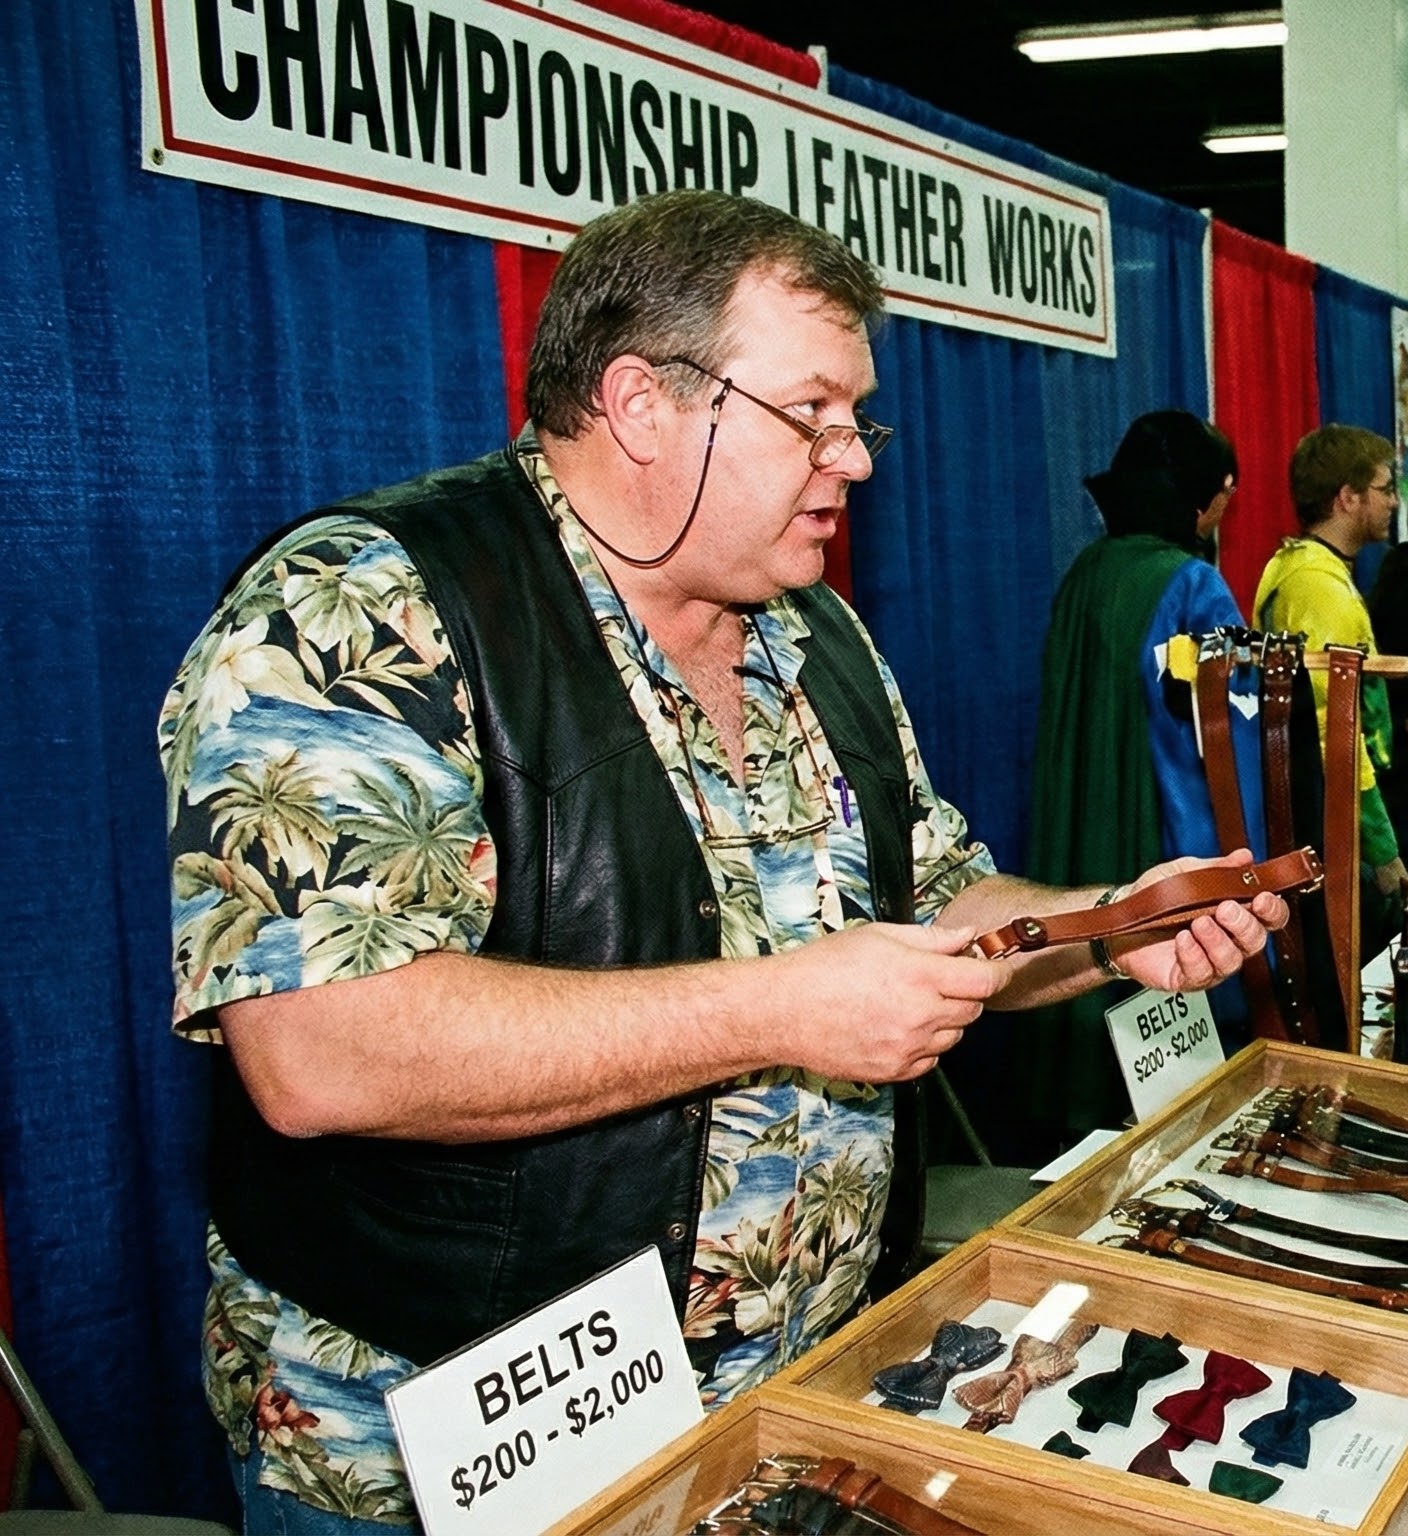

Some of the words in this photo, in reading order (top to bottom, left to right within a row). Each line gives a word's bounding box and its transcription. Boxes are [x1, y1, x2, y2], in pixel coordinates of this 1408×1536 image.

[196, 0, 759, 206] CHAMPIONSHIP
[982, 194, 1096, 318] WORKS
[1134, 1047, 1163, 1082] $200
[1171, 1018, 1208, 1058] $2,000
[1136, 993, 1188, 1041] BELTS
[474, 1309, 618, 1425] BELTS
[451, 1429, 537, 1511] $200
[547, 1430, 559, 1441] -
[564, 1348, 664, 1437] $2,000
